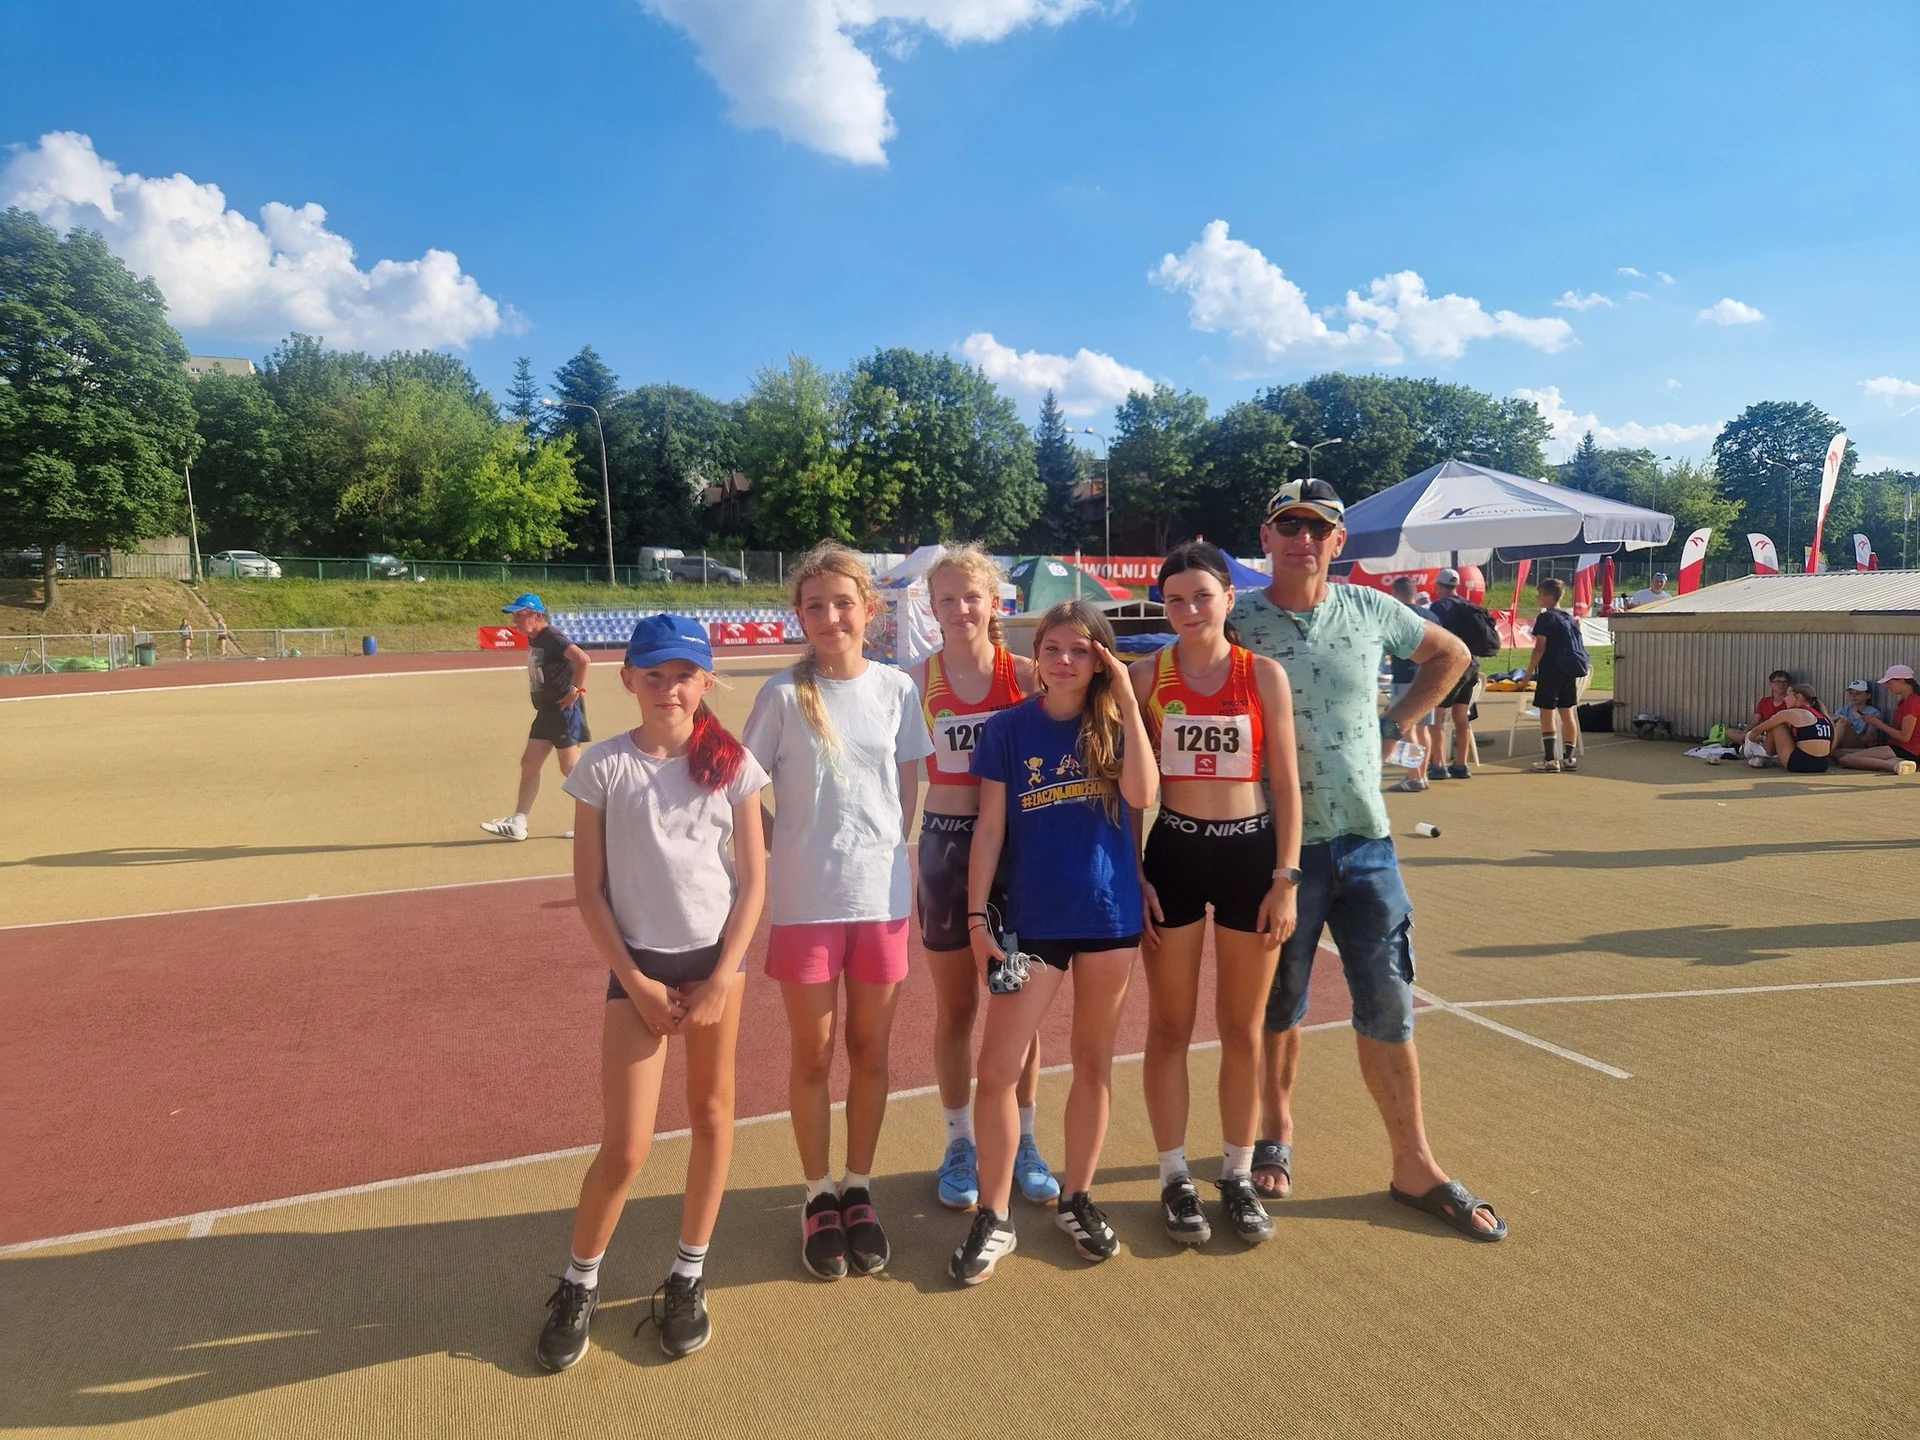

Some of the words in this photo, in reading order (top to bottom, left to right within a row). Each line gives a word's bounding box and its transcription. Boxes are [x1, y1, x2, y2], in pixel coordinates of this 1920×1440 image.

[1380, 573, 1429, 587] OEN
[725, 637, 748, 645] ORLEN
[1815, 724, 1831, 738] 511
[1174, 725, 1239, 754] 1263
[1204, 818, 1259, 837] NIKE
